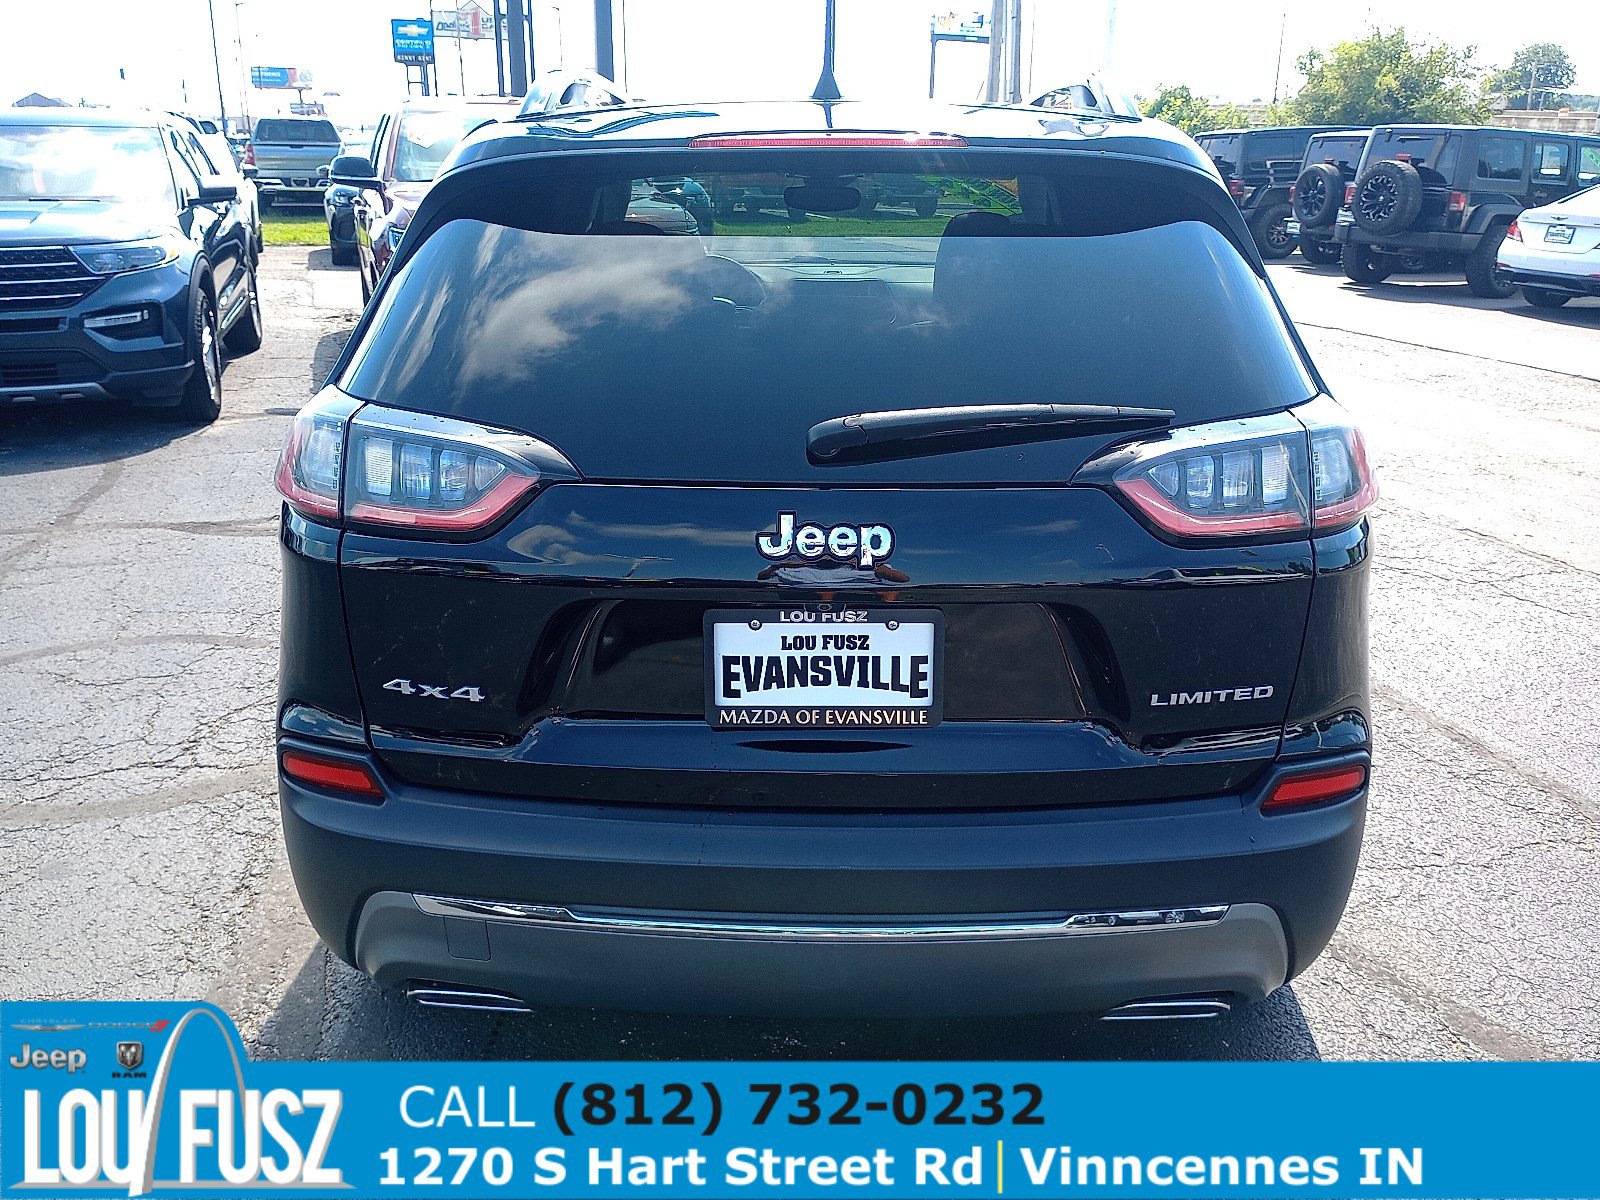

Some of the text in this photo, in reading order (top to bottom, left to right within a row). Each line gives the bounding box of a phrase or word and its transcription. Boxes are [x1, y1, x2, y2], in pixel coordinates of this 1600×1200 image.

[757, 511, 895, 569] Jeep
[779, 610, 868, 623] LOU FUSZ
[780, 634, 870, 651] LOU FUSZ
[721, 655, 929, 698] EVANSVILLE
[382, 678, 486, 703] 4x4
[1150, 685, 1274, 706] LIMITED
[719, 708, 928, 725] MAZDA OF EVANSVILLE
